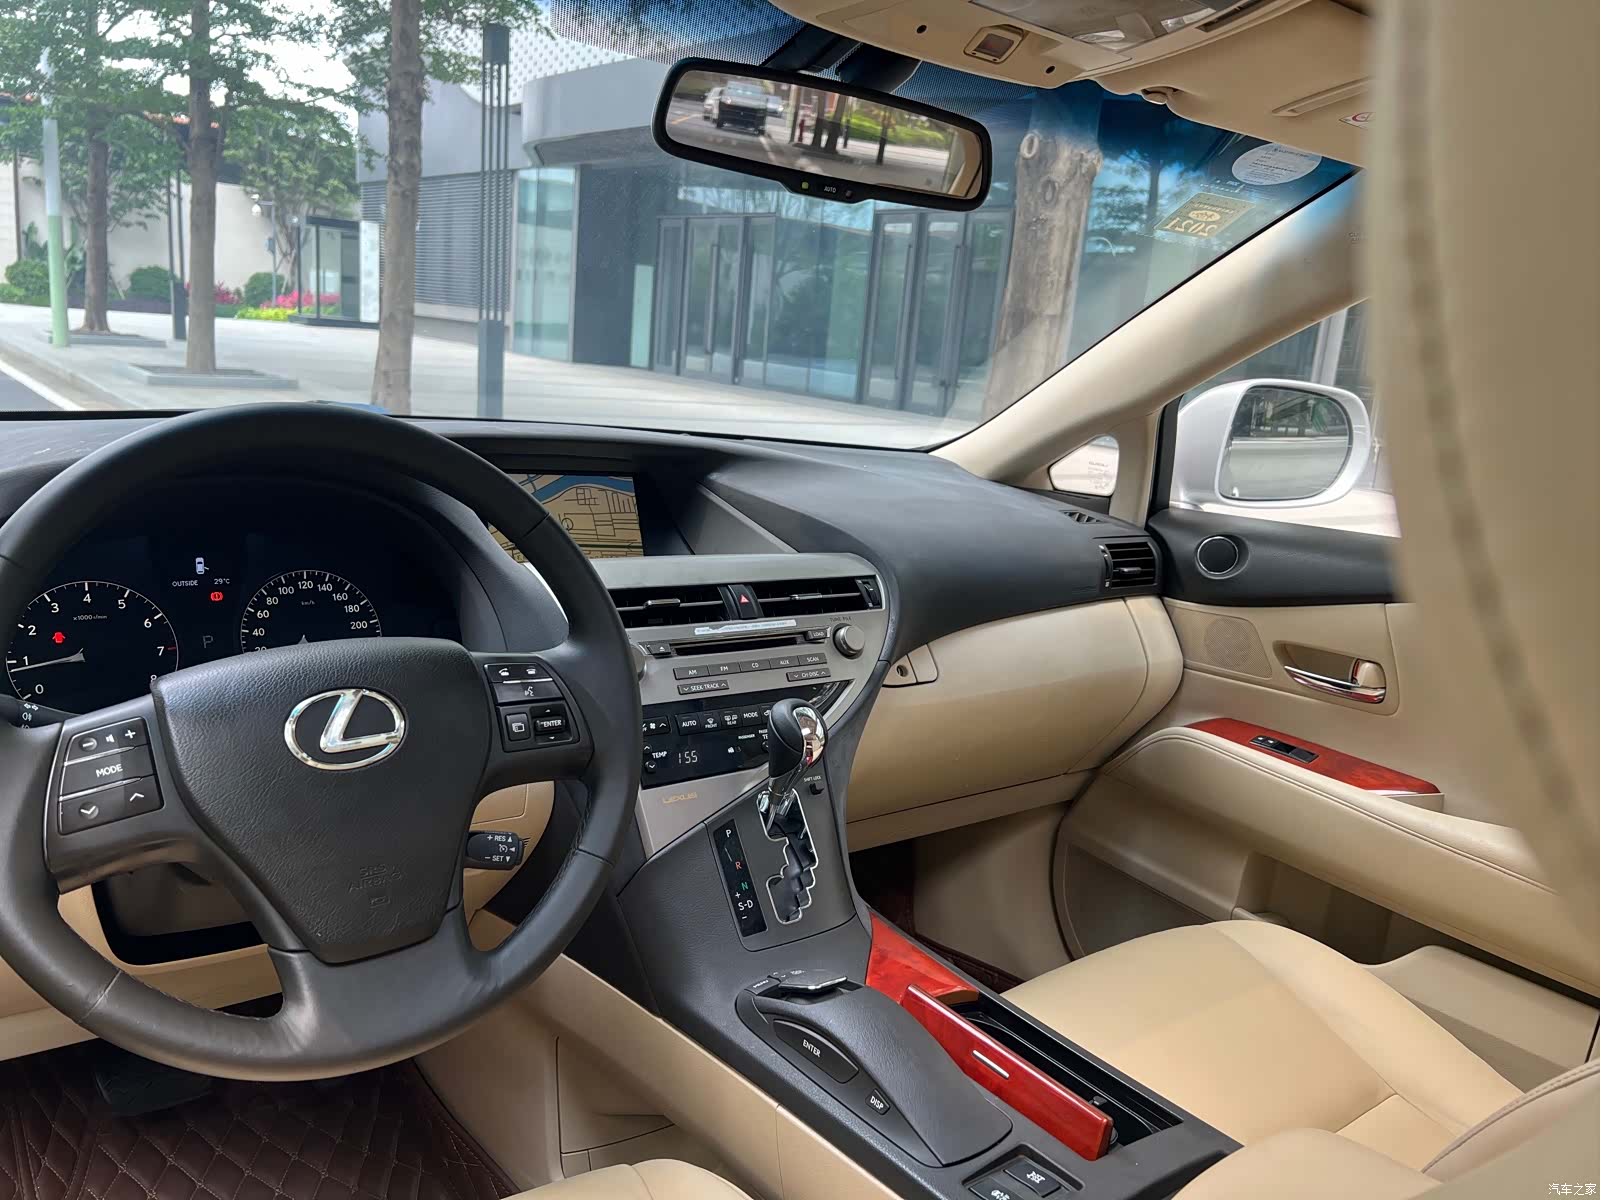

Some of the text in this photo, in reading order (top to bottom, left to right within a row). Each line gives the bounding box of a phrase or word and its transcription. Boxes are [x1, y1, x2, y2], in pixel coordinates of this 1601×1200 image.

[298, 580, 314, 589] 120
[317, 583, 332, 592] 140
[278, 586, 294, 594] 100
[83, 593, 91, 603] 4
[266, 596, 278, 606] 80
[332, 592, 348, 601] 160
[51, 602, 60, 613] 3
[118, 599, 126, 610] 5
[344, 604, 360, 613] 180
[256, 610, 270, 618] 60
[144, 618, 152, 628] 6
[350, 621, 368, 630] 200
[28, 626, 36, 636] 2
[252, 628, 265, 636] 40
[202, 635, 214, 648] P
[156, 646, 164, 656] 7
[23, 656, 28, 666] 1
[35, 684, 44, 694] 0
[544, 720, 562, 728] ENTER
[652, 751, 668, 759] TEMP
[96, 764, 123, 778] MODE
[726, 829, 732, 838] P
[735, 862, 742, 870] R
[741, 882, 748, 890] N
[802, 1039, 821, 1058] ENTER
[870, 1096, 884, 1110] DISP
